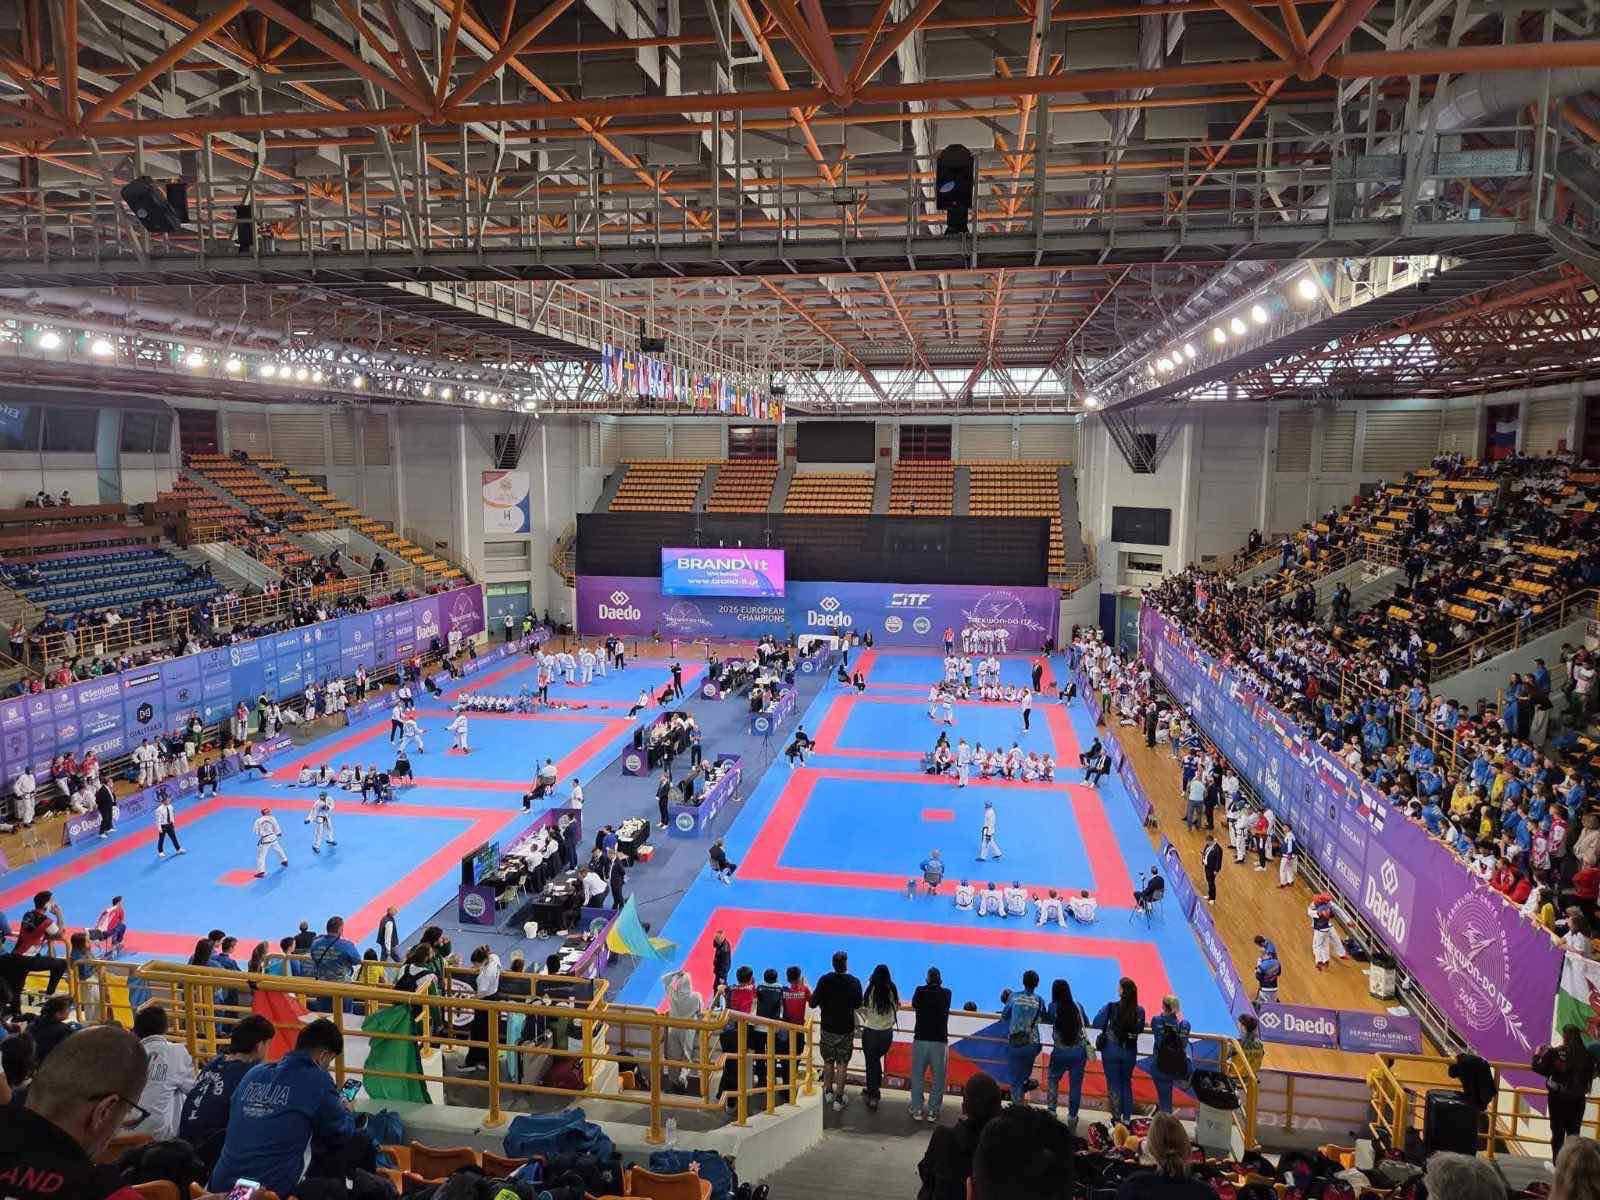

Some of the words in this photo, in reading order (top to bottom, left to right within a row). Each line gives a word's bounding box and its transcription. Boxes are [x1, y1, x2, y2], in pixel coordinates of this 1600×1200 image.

[599, 604, 641, 621] Daedo
[737, 613, 785, 624] CHAMPIONS
[740, 606, 785, 616] EUROPEAN
[807, 610, 852, 628] Daedo
[416, 623, 438, 640] Daedo
[82, 813, 102, 832] Daed
[1363, 876, 1406, 945] Daedo
[1284, 1013, 1336, 1036] Daedo
